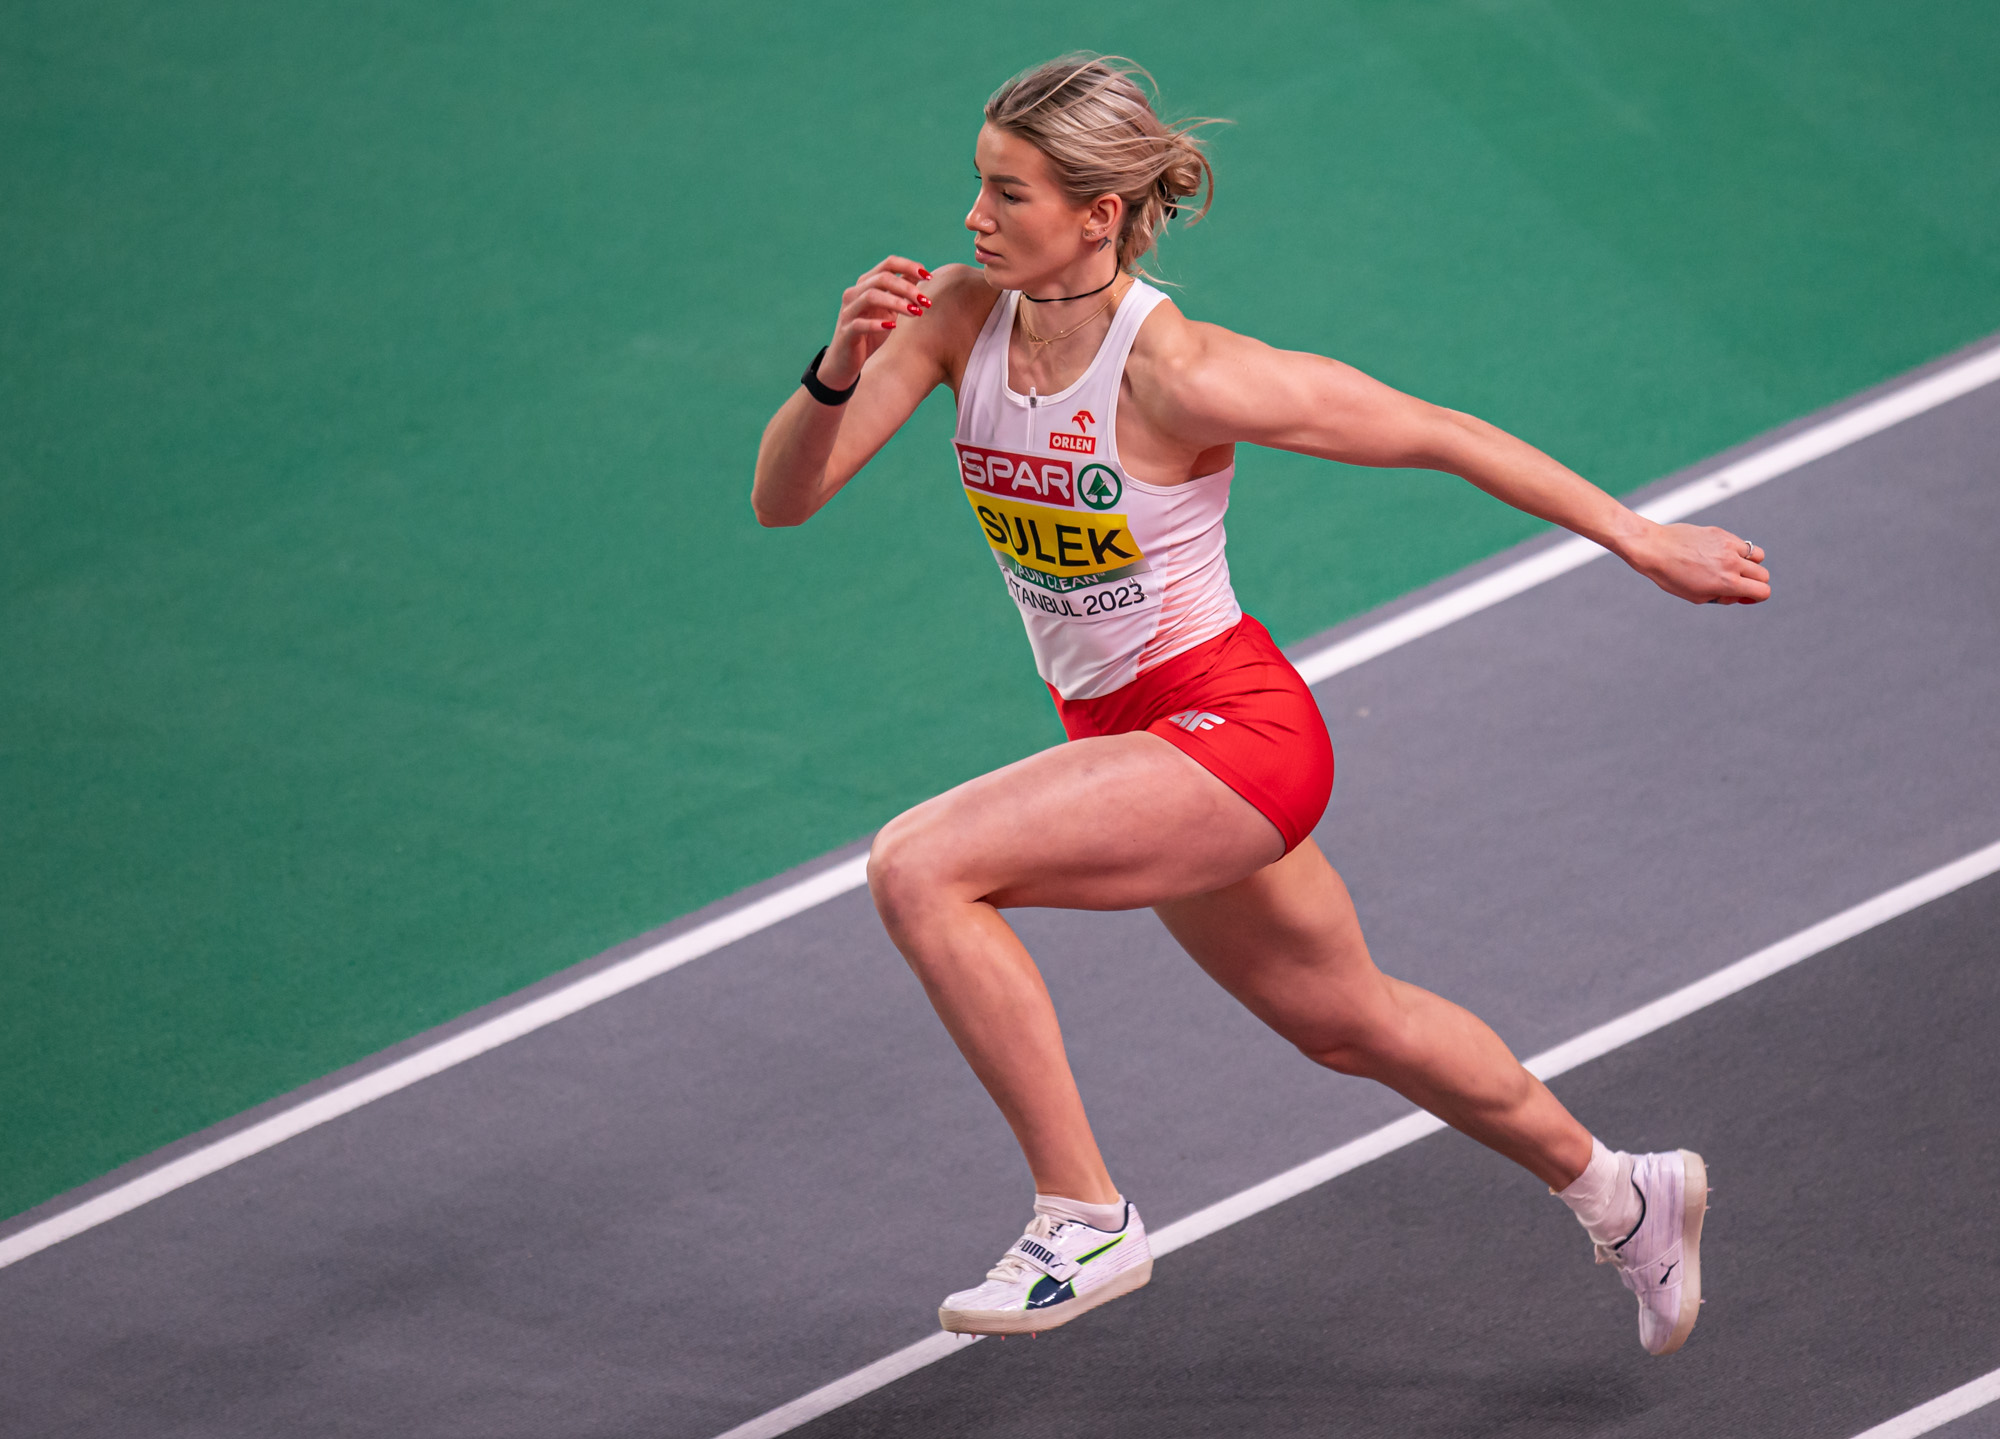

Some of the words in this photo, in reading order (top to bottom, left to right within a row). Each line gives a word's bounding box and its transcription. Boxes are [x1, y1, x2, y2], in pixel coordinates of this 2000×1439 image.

[1052, 435, 1092, 451] ORLEN
[962, 451, 1071, 499] SPAR
[977, 505, 1136, 567] SULEK
[1018, 565, 1045, 585] RUN
[1083, 583, 1145, 616] 2023
